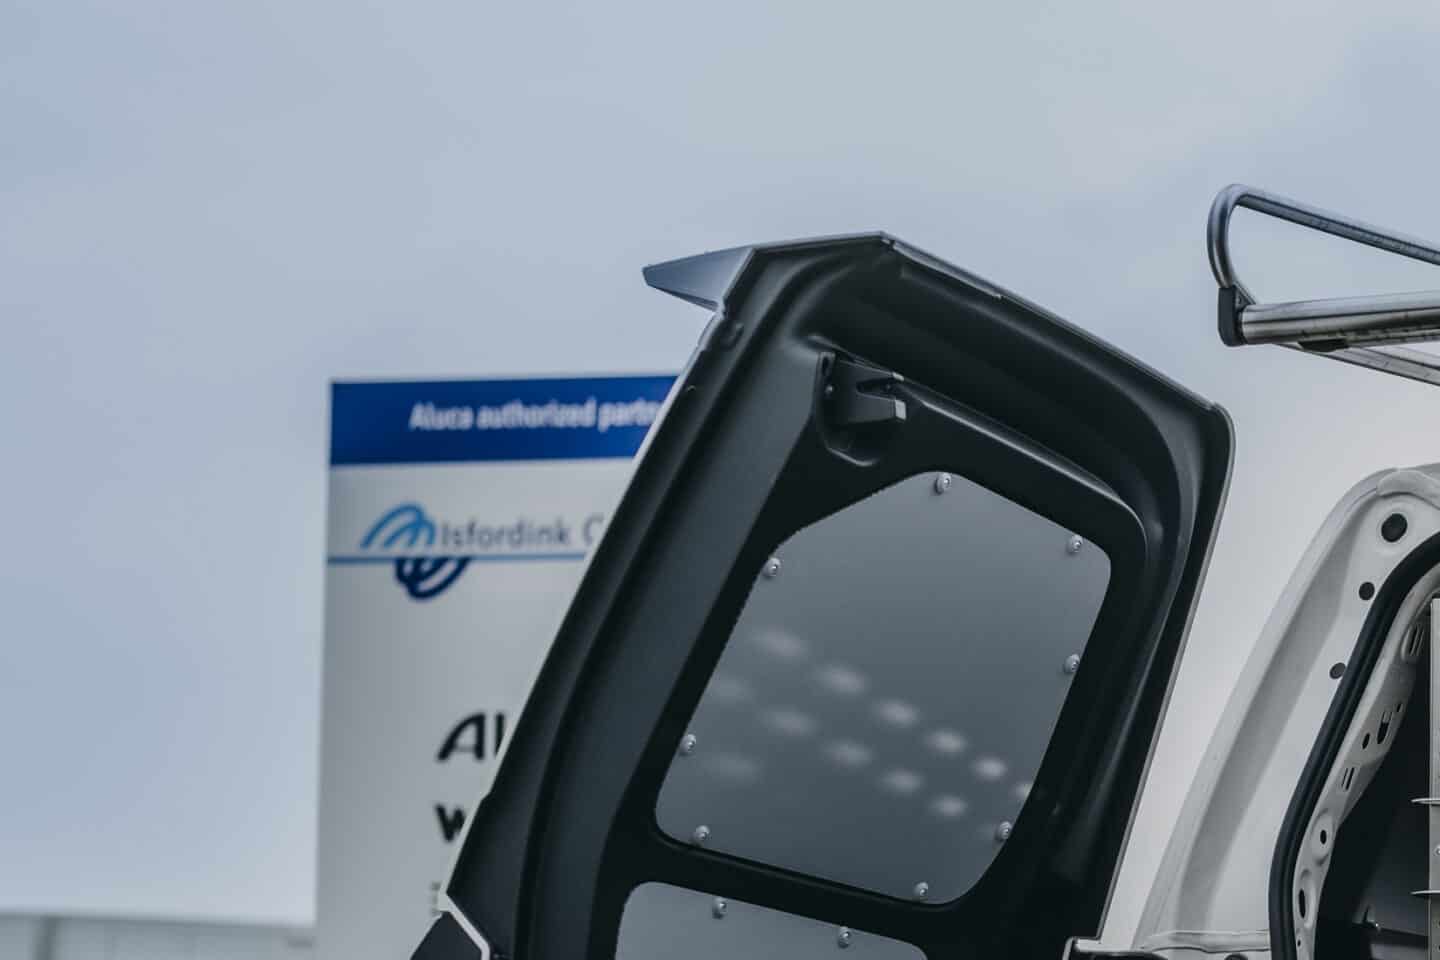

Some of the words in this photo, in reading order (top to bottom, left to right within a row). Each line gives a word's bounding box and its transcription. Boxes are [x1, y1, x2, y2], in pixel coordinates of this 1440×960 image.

[408, 400, 474, 431] Aluca
[476, 398, 595, 428] authorized
[597, 399, 665, 432] partn
[441, 517, 570, 549] Isfordink
